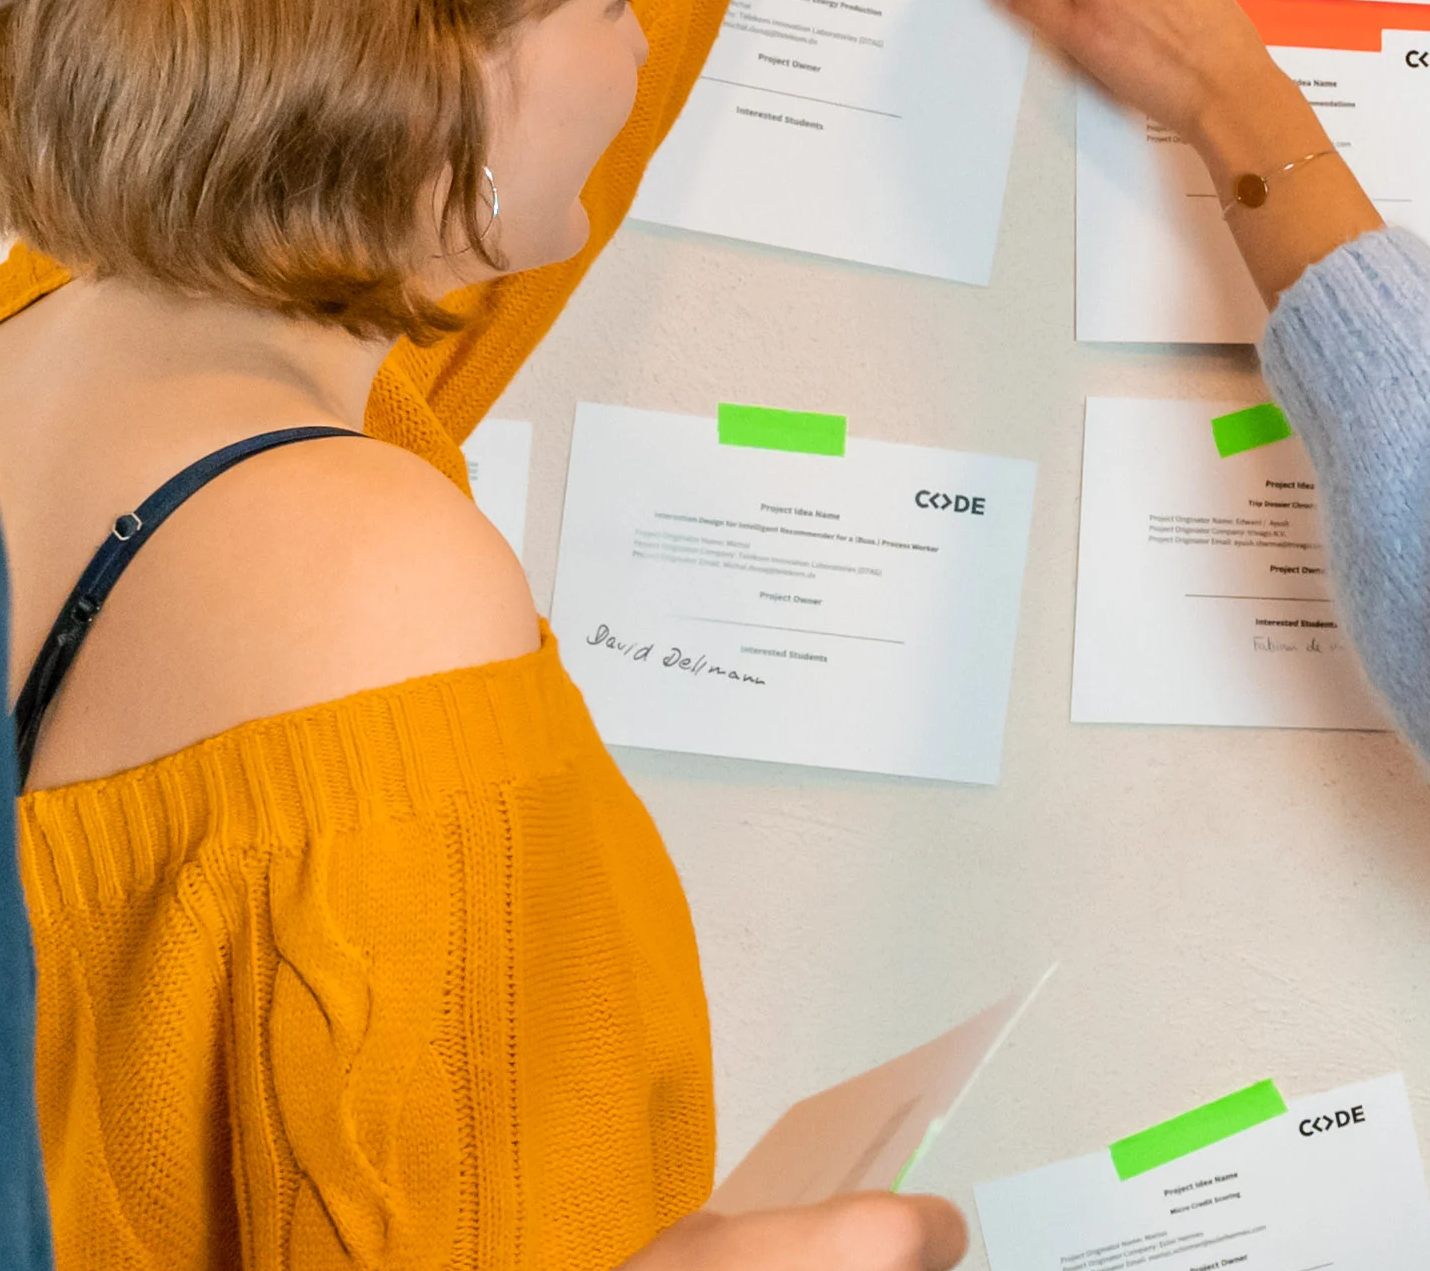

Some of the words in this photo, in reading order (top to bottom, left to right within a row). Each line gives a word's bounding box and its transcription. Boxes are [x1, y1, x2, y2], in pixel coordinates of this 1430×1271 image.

[758, 53, 791, 67] Project
[792, 59, 822, 73] Owner
[1314, 79, 1338, 88] Name
[736, 106, 783, 123] Interested
[784, 115, 824, 130] Students
[1265, 479, 1296, 491] Project
[1297, 481, 1315, 490] Idea
[760, 502, 792, 516] Project
[794, 506, 813, 517] Idea
[815, 508, 841, 520] Name
[1149, 514, 1174, 524] Project
[698, 516, 724, 528] Design
[725, 519, 738, 527] for
[738, 520, 779, 533] Intelligent
[779, 526, 835, 540] Recommender
[836, 533, 847, 541] for
[881, 539, 911, 549] Process
[1149, 524, 1174, 534] Project
[1148, 535, 1173, 545] Project
[1270, 564, 1300, 576] Project
[759, 590, 791, 603] Project
[793, 594, 822, 606] Owner
[1255, 618, 1299, 628] Interested
[585, 623, 653, 664] David
[740, 644, 787, 658] Interested
[788, 650, 828, 663] Students
[1163, 1182, 1194, 1197] Project
[1195, 1178, 1213, 1189] Idea
[1214, 1172, 1238, 1184] Name
[1170, 1204, 1190, 1215] Micro
[1190, 1198, 1213, 1210] Credit
[1220, 1254, 1248, 1267] Owner
